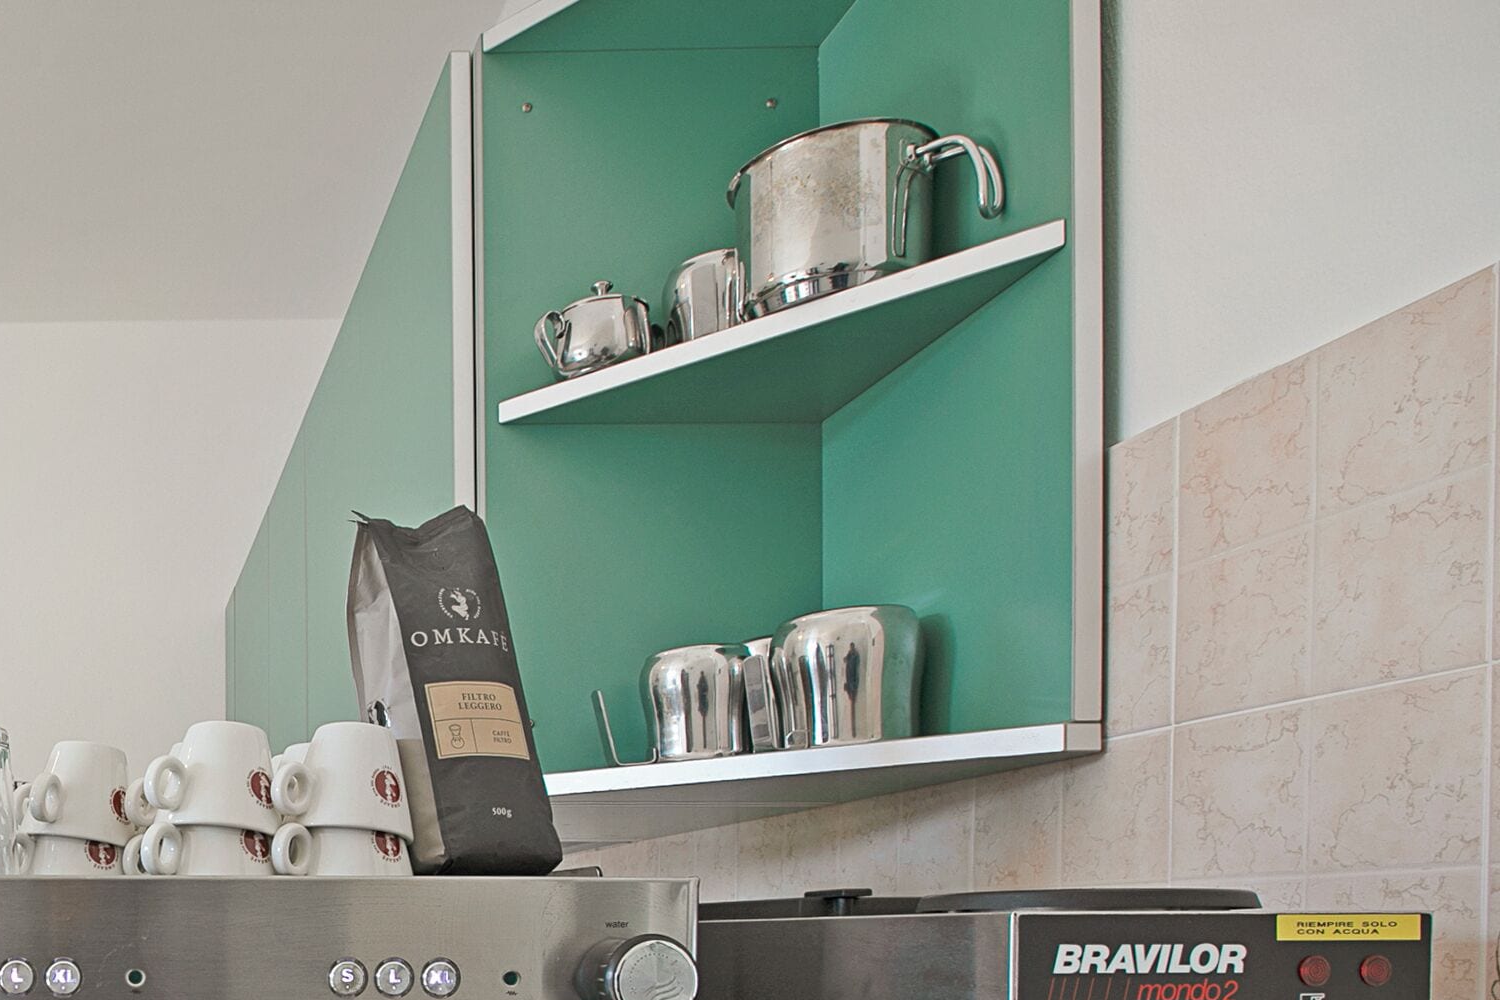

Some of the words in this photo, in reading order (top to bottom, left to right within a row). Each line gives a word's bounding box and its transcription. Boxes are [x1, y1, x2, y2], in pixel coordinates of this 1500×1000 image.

[461, 693, 496, 701] FILTRO
[458, 702, 502, 711] LEGGERO
[492, 807, 512, 819] 500g
[604, 920, 629, 928] water
[1052, 943, 1248, 975] BRAVILOR
[10, 967, 24, 983] L
[52, 969, 77, 983] XL
[341, 968, 354, 983] S
[389, 968, 401, 984] L
